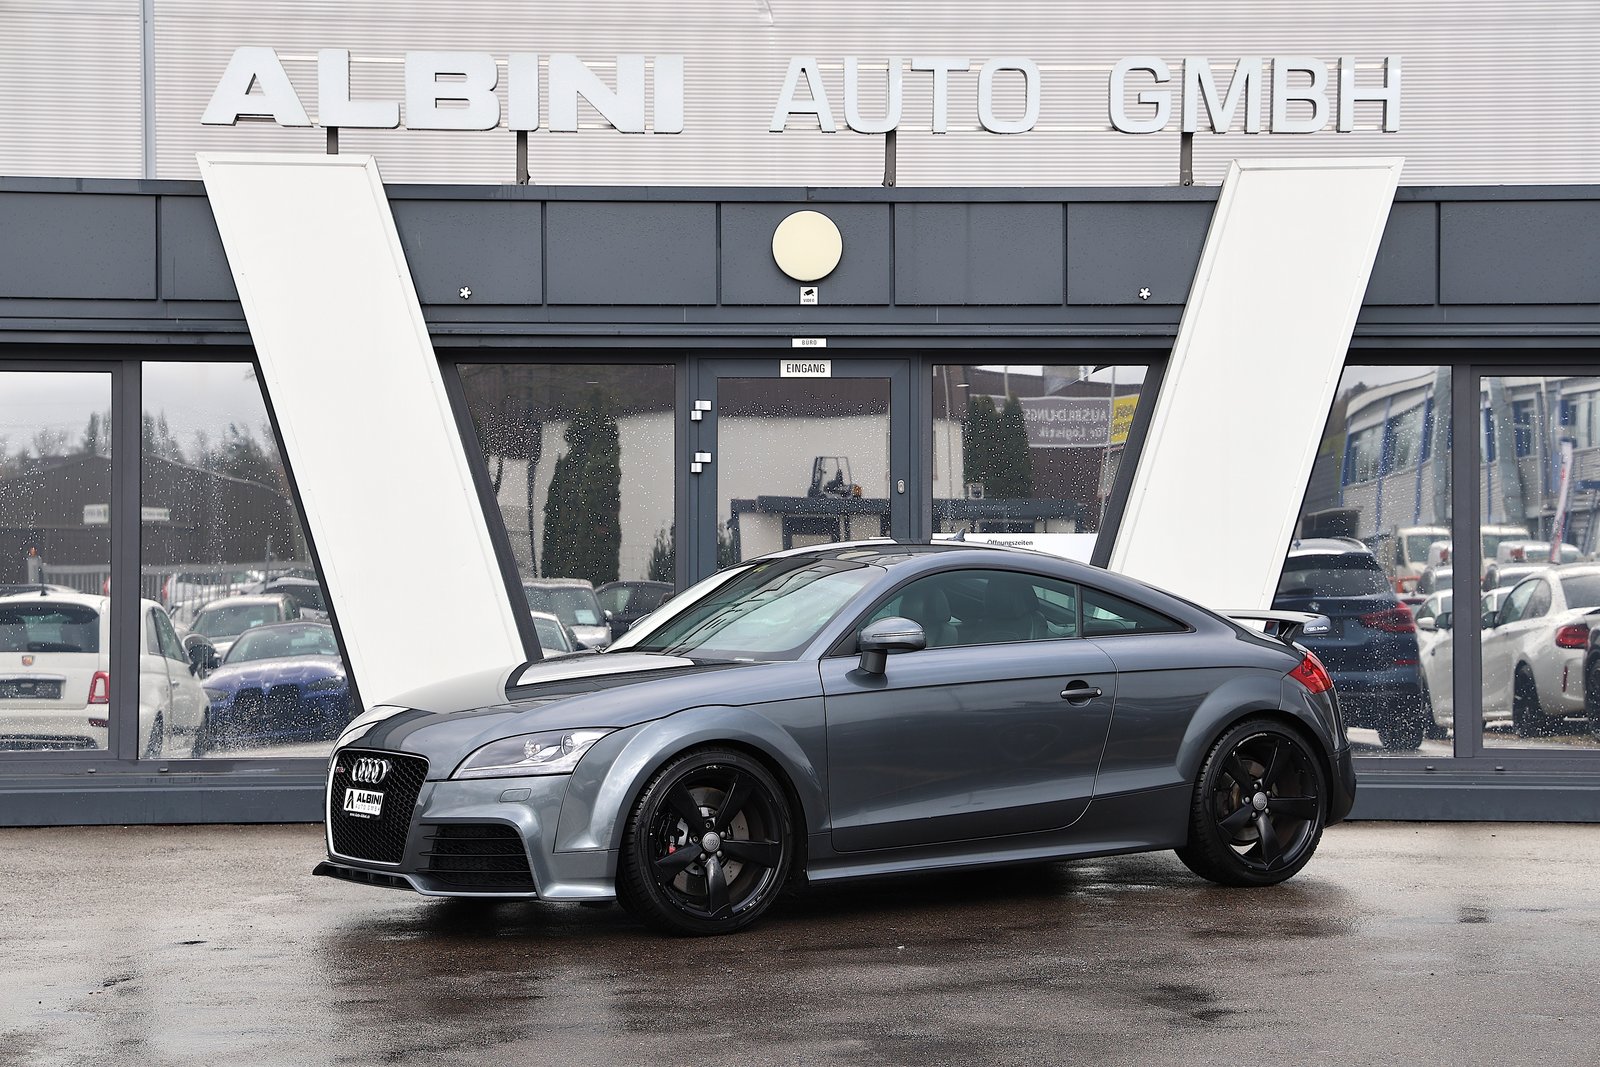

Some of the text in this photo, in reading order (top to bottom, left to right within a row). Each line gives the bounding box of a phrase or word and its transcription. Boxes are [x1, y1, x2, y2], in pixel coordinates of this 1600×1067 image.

[201, 46, 1402, 134] ALBINI AUTO GMBH
[786, 363, 826, 373] EINGANG
[986, 539, 1034, 547] Öffnungszeiten
[356, 792, 382, 805] ALBINI
